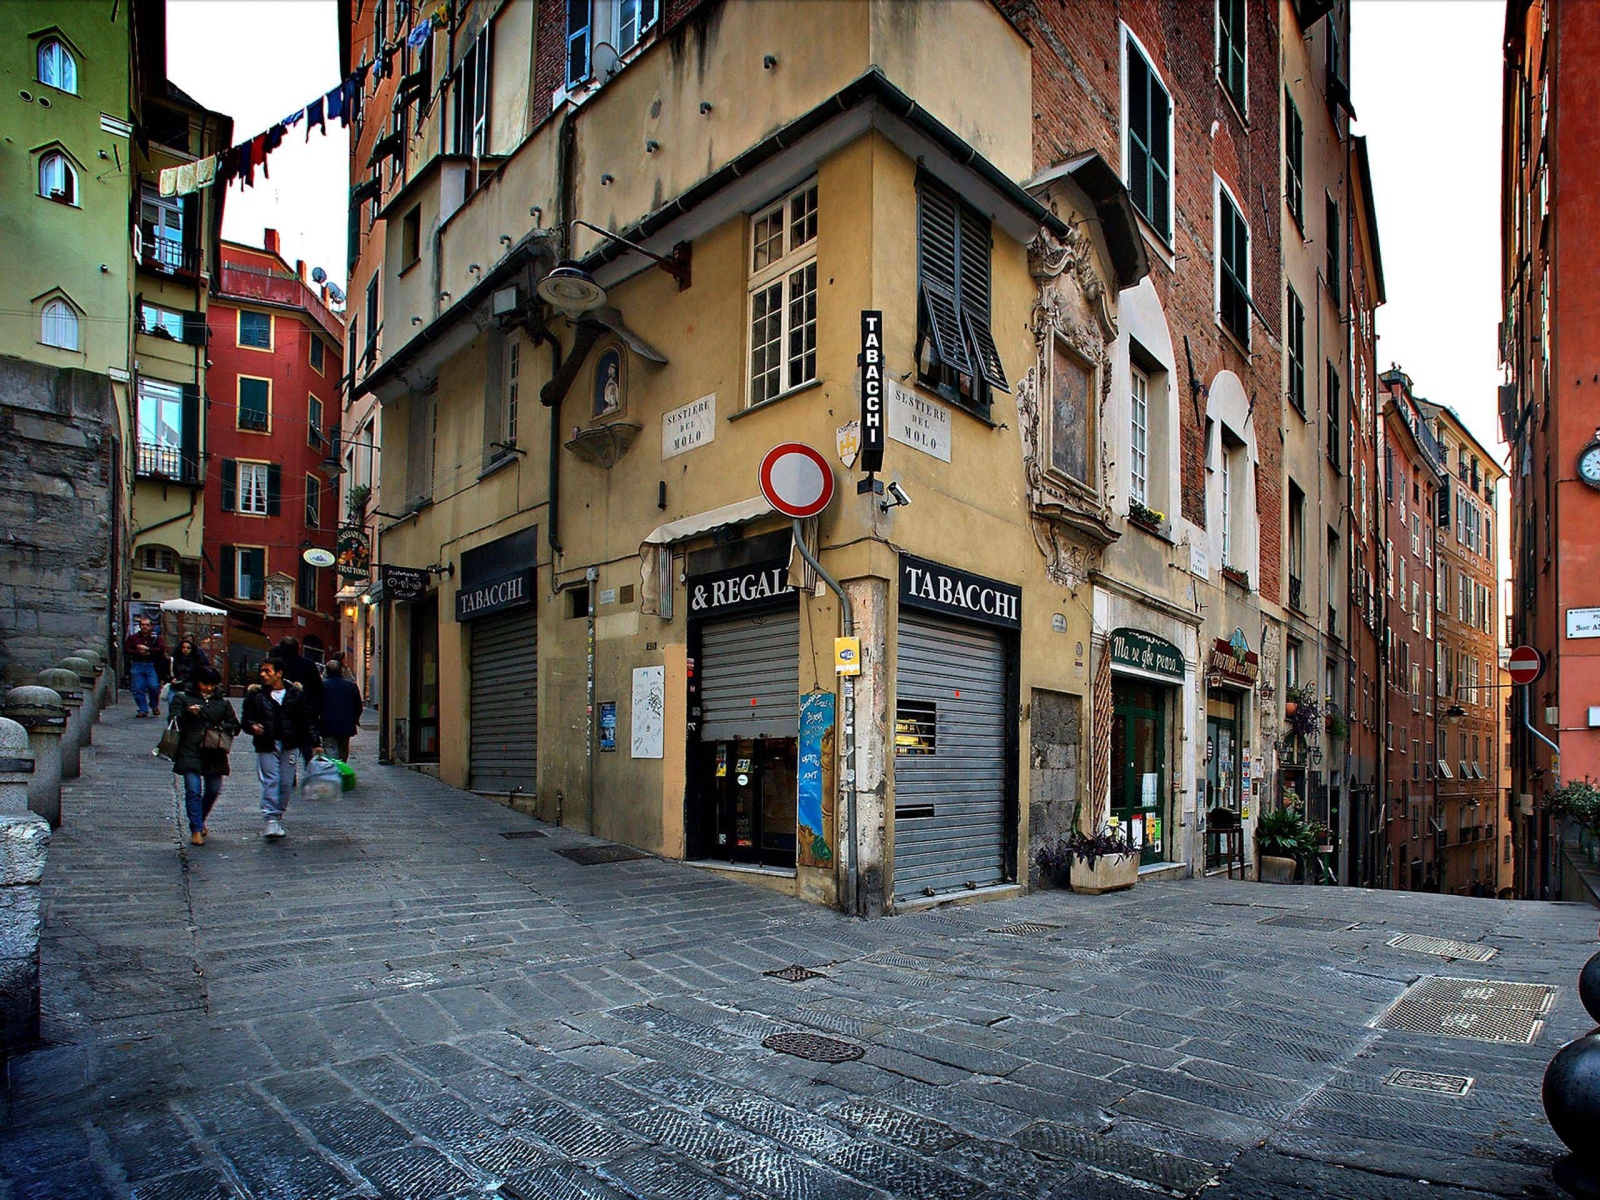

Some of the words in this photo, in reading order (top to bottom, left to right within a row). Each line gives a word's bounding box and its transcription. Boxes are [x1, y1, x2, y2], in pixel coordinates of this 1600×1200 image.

[865, 317, 880, 443] TABACCHI
[667, 400, 710, 426] SESTIERE
[895, 389, 946, 423] SESTIERE
[680, 421, 696, 433] DEL
[912, 414, 930, 430] DEL
[674, 430, 702, 450] MOLO
[904, 425, 937, 450] MOLO
[460, 576, 523, 614] TABACCHI
[691, 585, 709, 611] &
[905, 565, 1018, 621] TABACCHI
[1113, 636, 1129, 660] Ma
[1131, 647, 1140, 663] se
[1141, 644, 1154, 670] ghe
